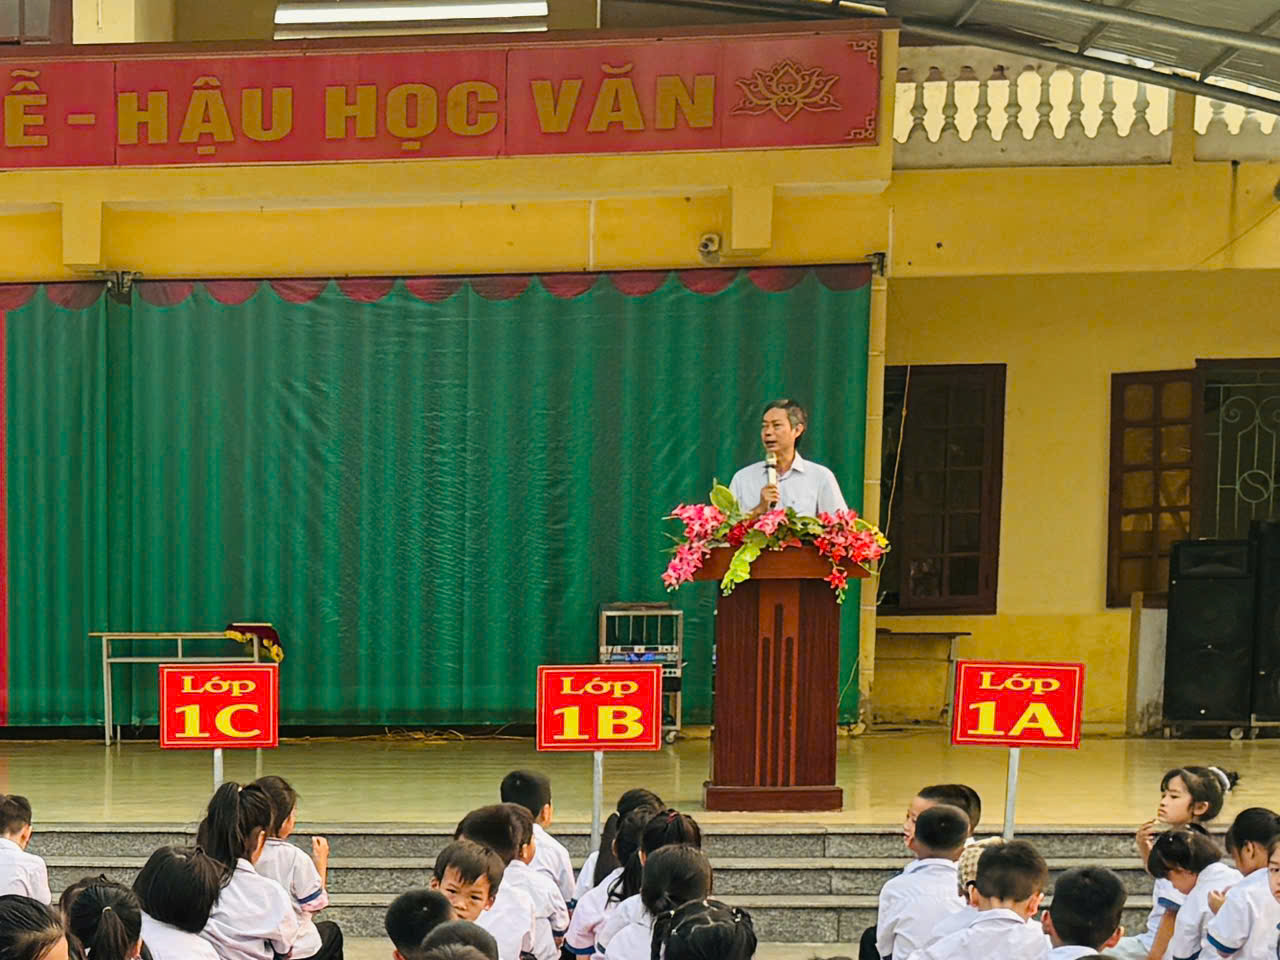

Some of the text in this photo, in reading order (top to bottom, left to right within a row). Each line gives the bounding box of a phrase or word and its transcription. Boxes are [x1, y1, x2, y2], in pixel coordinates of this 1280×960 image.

[117, 76, 293, 156] HẬU
[325, 80, 499, 151] HỌC
[531, 63, 716, 135] VĂN
[181, 675, 257, 697] Lớp
[560, 676, 639, 698] Lớp
[979, 671, 1061, 695] Lớp
[175, 703, 262, 738] 1C
[553, 705, 645, 740] 1B
[967, 700, 1065, 738] 1A
